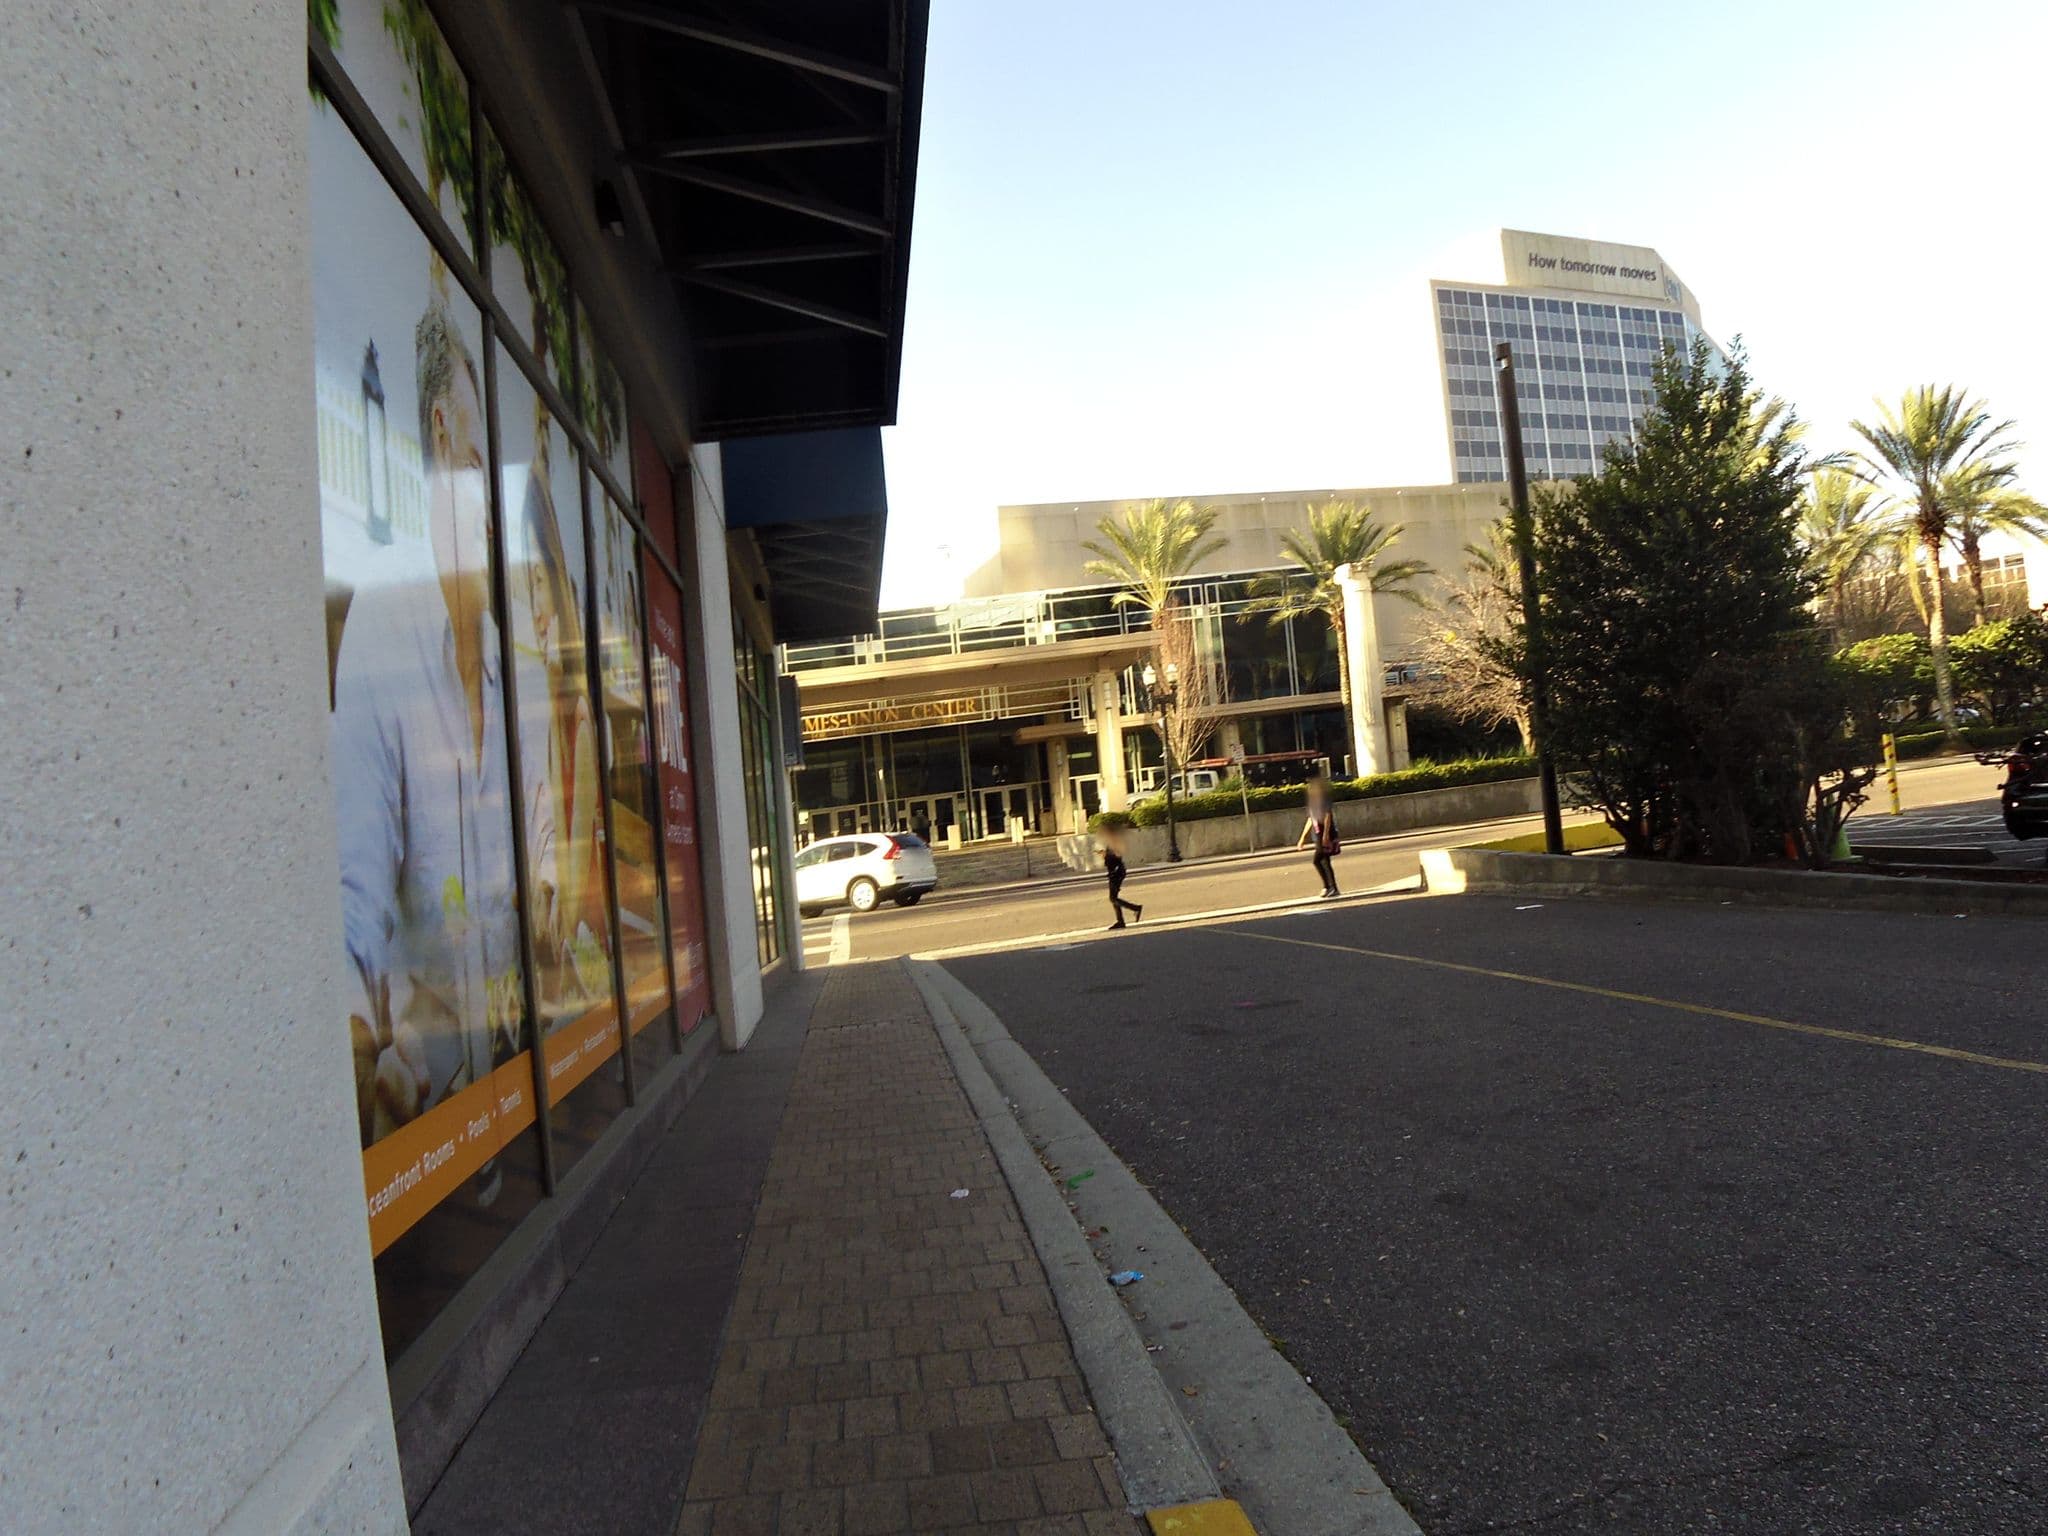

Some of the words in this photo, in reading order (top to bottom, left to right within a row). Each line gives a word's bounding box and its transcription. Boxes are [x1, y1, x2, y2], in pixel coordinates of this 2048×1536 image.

[1528, 252, 1557, 270] How
[1559, 257, 1618, 277] tomorrow
[1619, 265, 1657, 281] moves
[804, 706, 900, 733] MES-UNION
[911, 698, 977, 720] CENTER
[368, 1160, 422, 1218] ceanfront
[423, 1139, 456, 1176] Rooms
